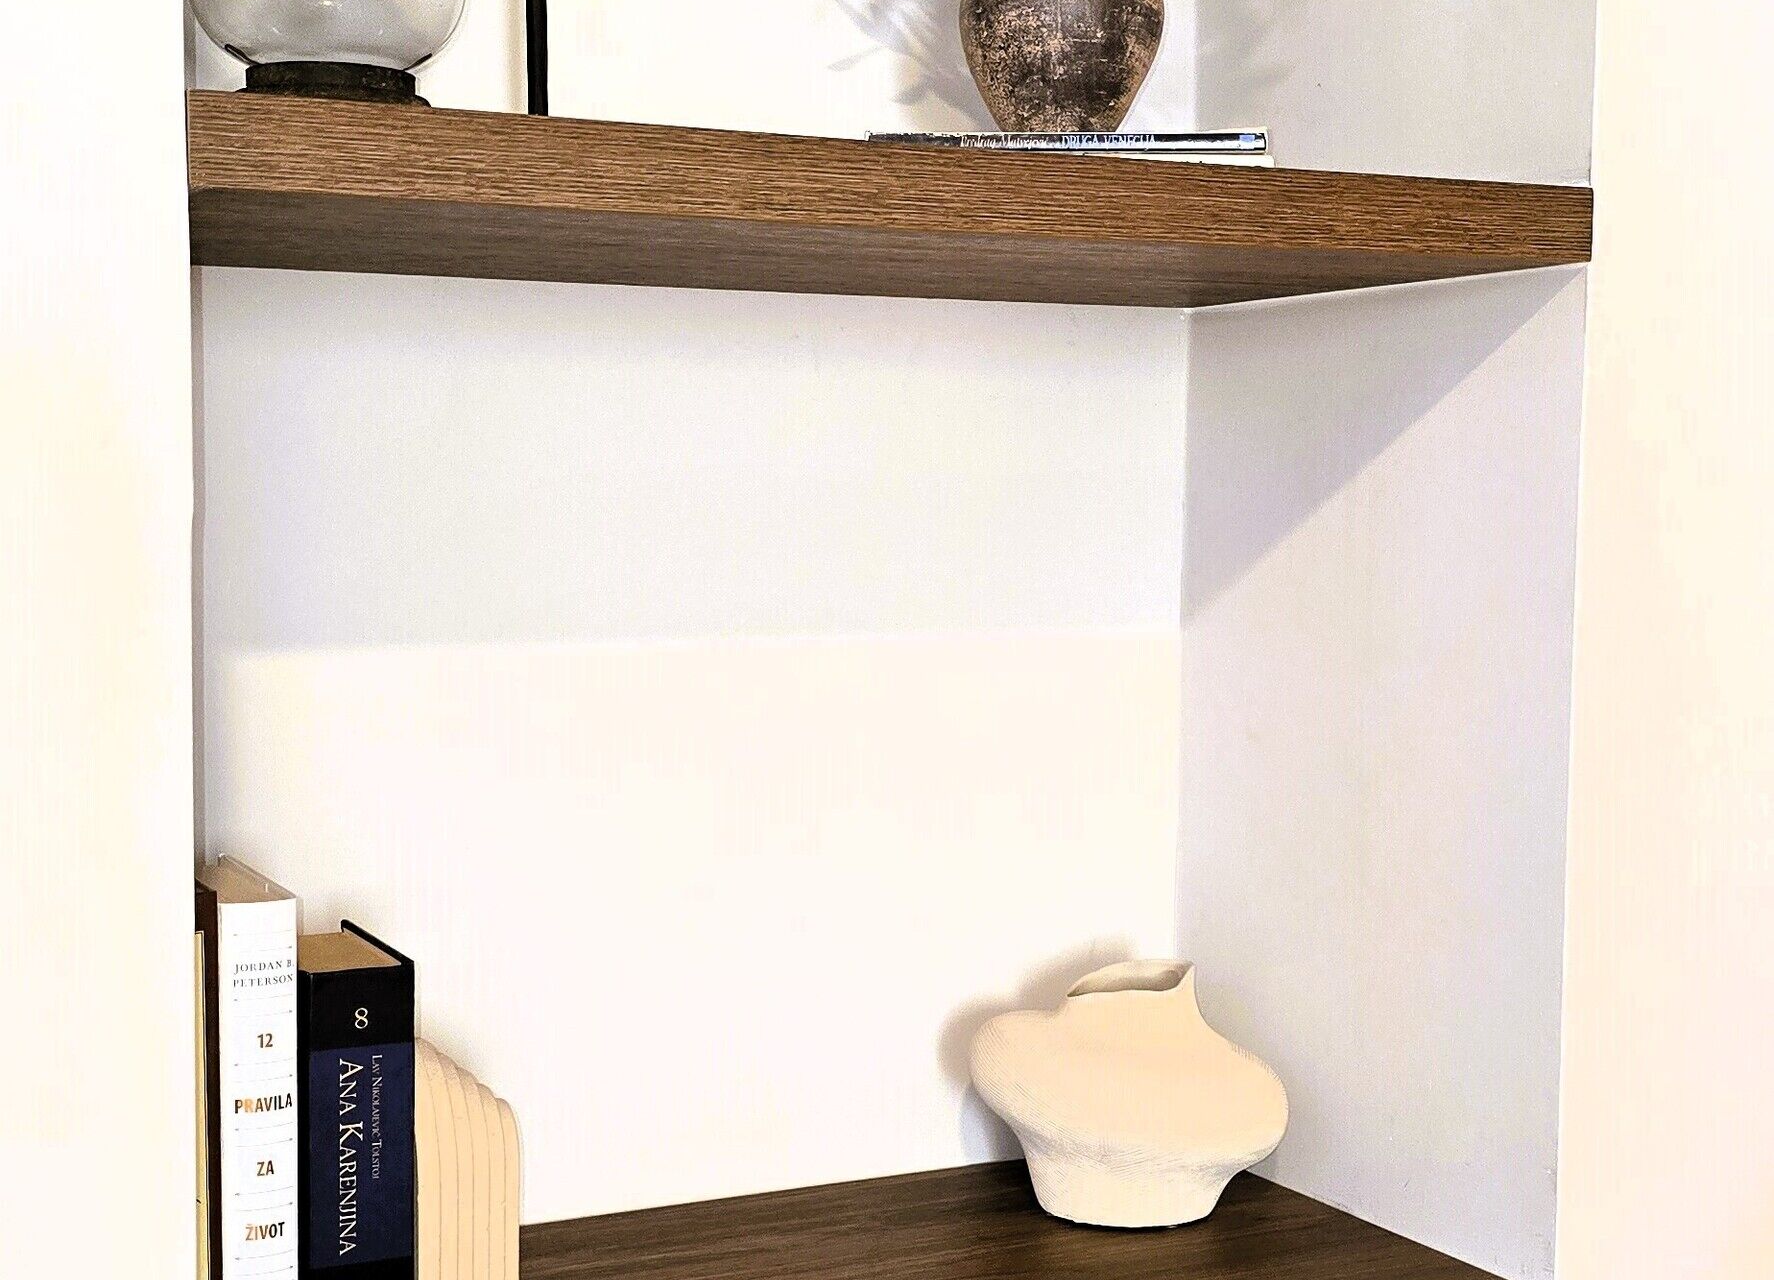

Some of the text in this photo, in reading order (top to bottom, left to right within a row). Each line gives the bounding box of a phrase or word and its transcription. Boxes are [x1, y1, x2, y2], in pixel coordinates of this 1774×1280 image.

[234, 960, 283, 975] JORDAN
[233, 974, 294, 988] PETERSON
[354, 1007, 369, 1029] 8
[257, 1033, 274, 1049] 12
[234, 1093, 293, 1114] PRAVILA
[339, 1058, 364, 1256] ANA KARENJINA
[256, 1160, 275, 1177] ZA
[245, 1221, 286, 1241] ŽIVOT
